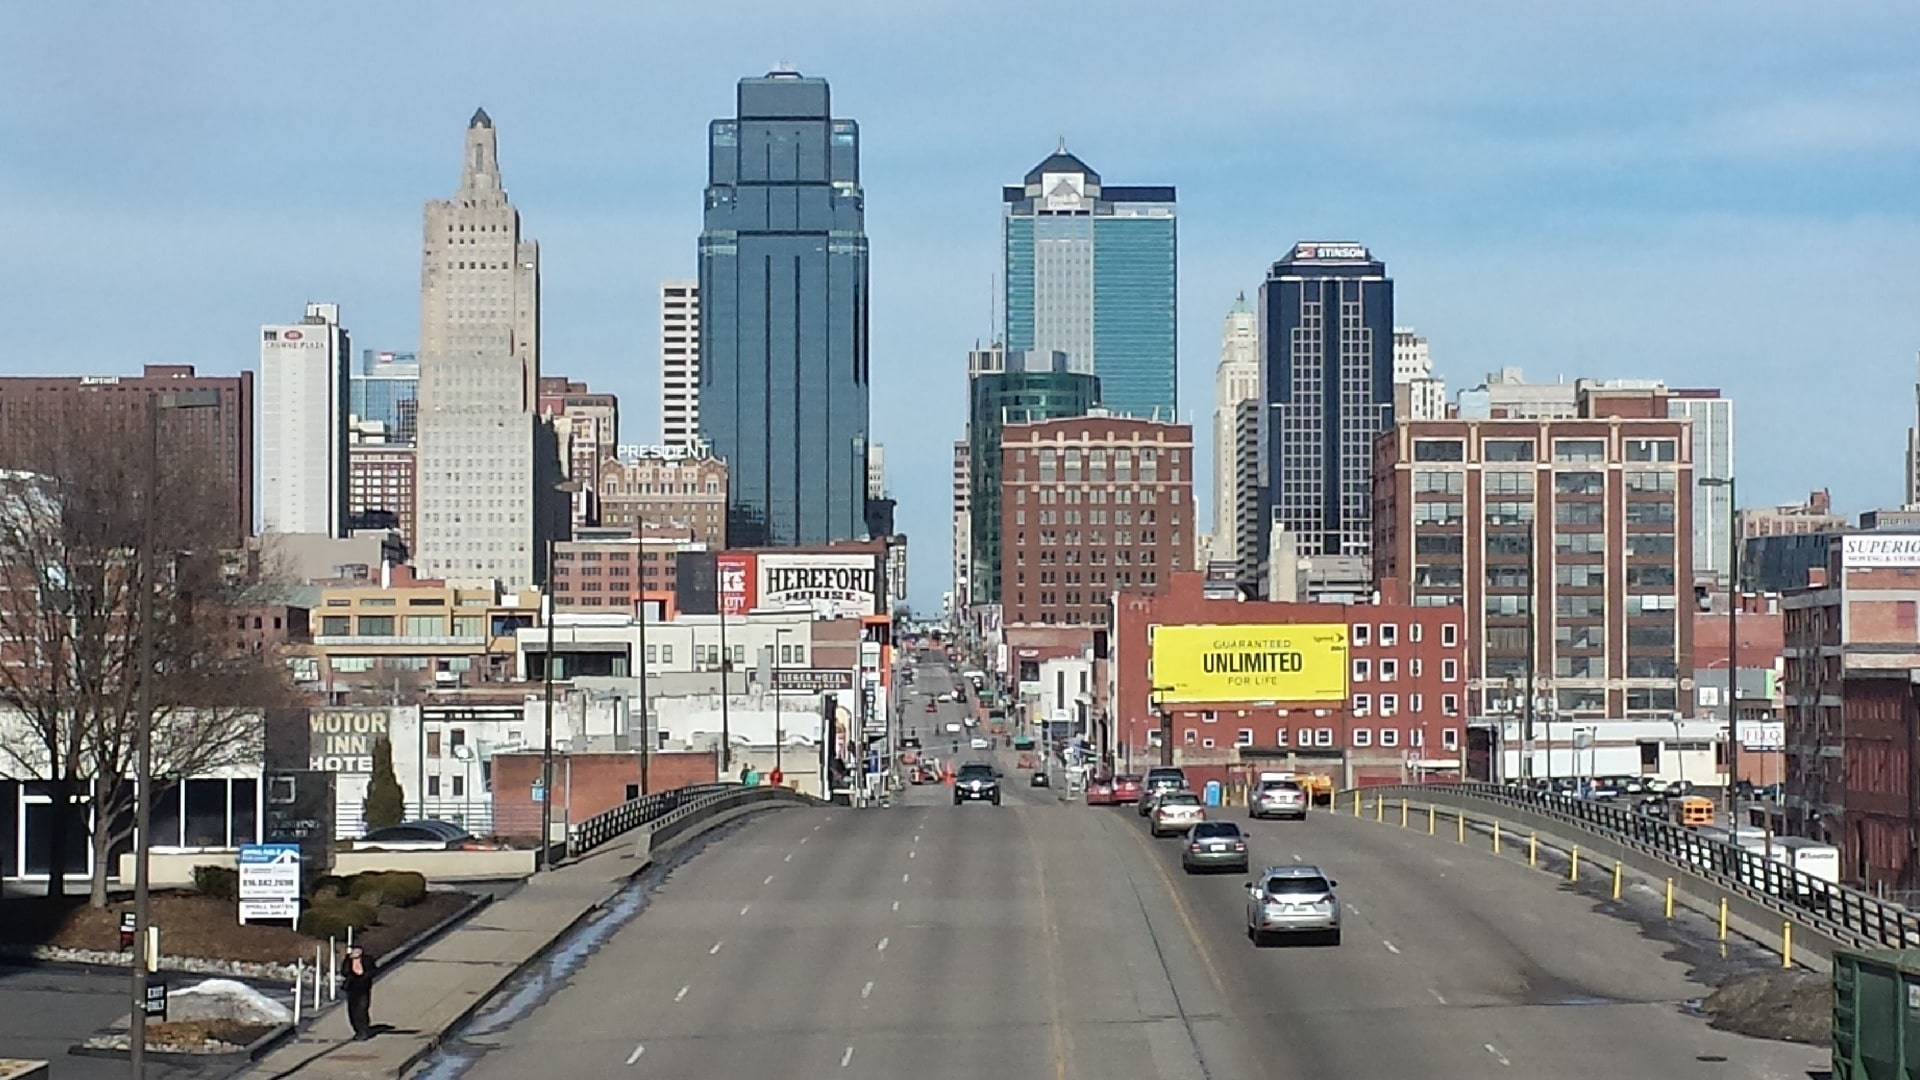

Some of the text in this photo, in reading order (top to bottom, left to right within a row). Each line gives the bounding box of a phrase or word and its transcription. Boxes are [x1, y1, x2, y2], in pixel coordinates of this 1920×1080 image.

[1317, 247, 1366, 258] STINSON
[617, 443, 711, 460] PRESIDENT
[765, 567, 876, 595] HEREFORD
[785, 590, 856, 602] HOUSE
[1213, 640, 1292, 649] GUARANTEED
[1203, 652, 1303, 673] UNLIMITED
[1227, 676, 1278, 686] FOR LIFE
[309, 711, 387, 733] MOTOR
[326, 735, 367, 754] INN
[308, 756, 374, 772] HOTE
